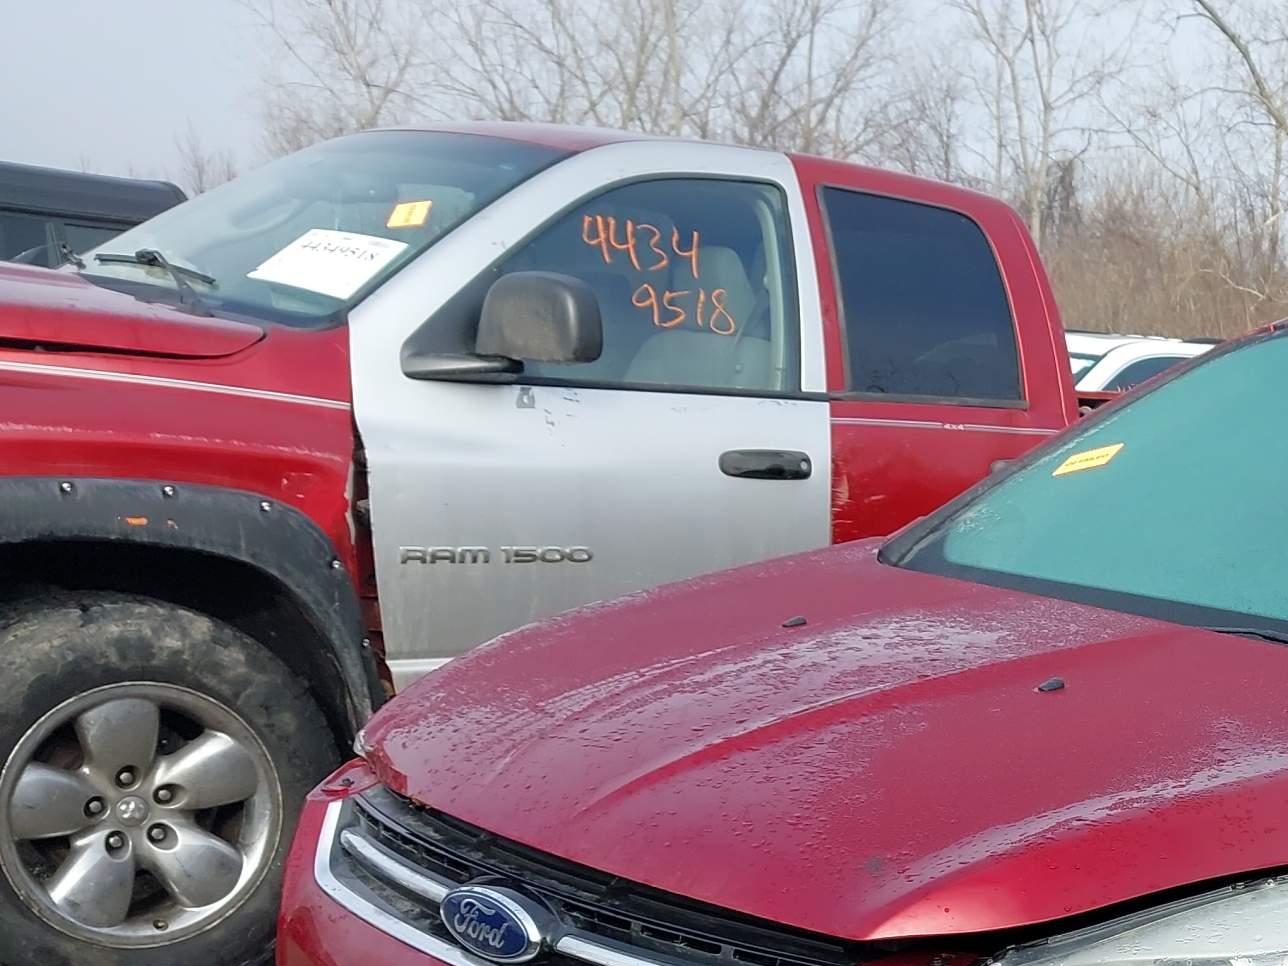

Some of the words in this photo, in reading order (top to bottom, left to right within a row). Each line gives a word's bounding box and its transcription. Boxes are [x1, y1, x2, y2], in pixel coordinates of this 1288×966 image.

[582, 214, 699, 279] 4434
[631, 283, 736, 335] 9518
[400, 545, 490, 565] RAM
[500, 545, 594, 564] 1500
[454, 898, 509, 949] Ford
